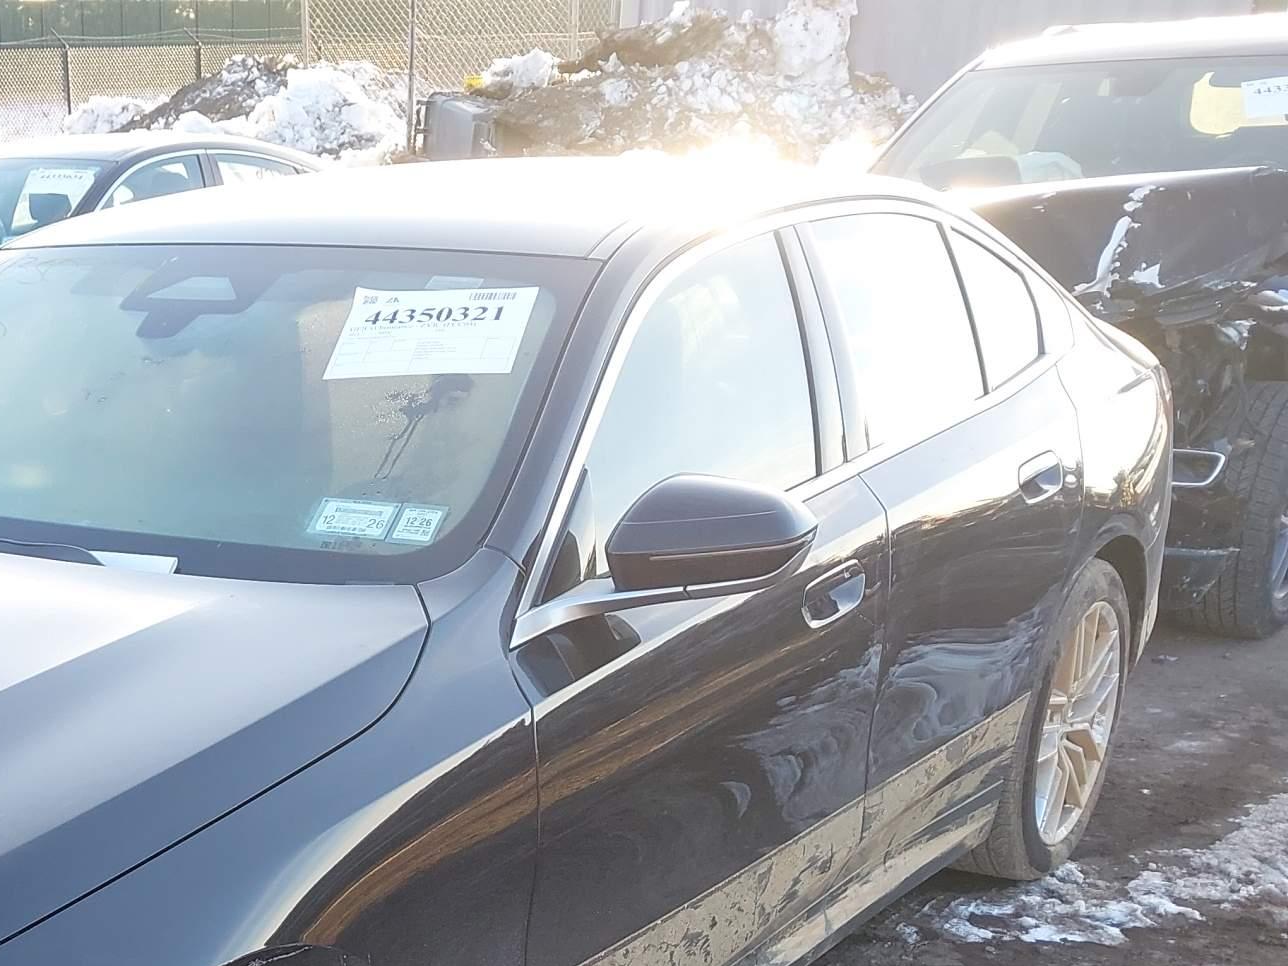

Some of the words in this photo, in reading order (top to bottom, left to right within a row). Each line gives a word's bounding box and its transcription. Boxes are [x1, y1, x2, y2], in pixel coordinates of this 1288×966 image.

[365, 305, 505, 325] 44350321
[322, 514, 336, 525] 12
[367, 518, 385, 529] 26
[418, 517, 433, 527] 26
